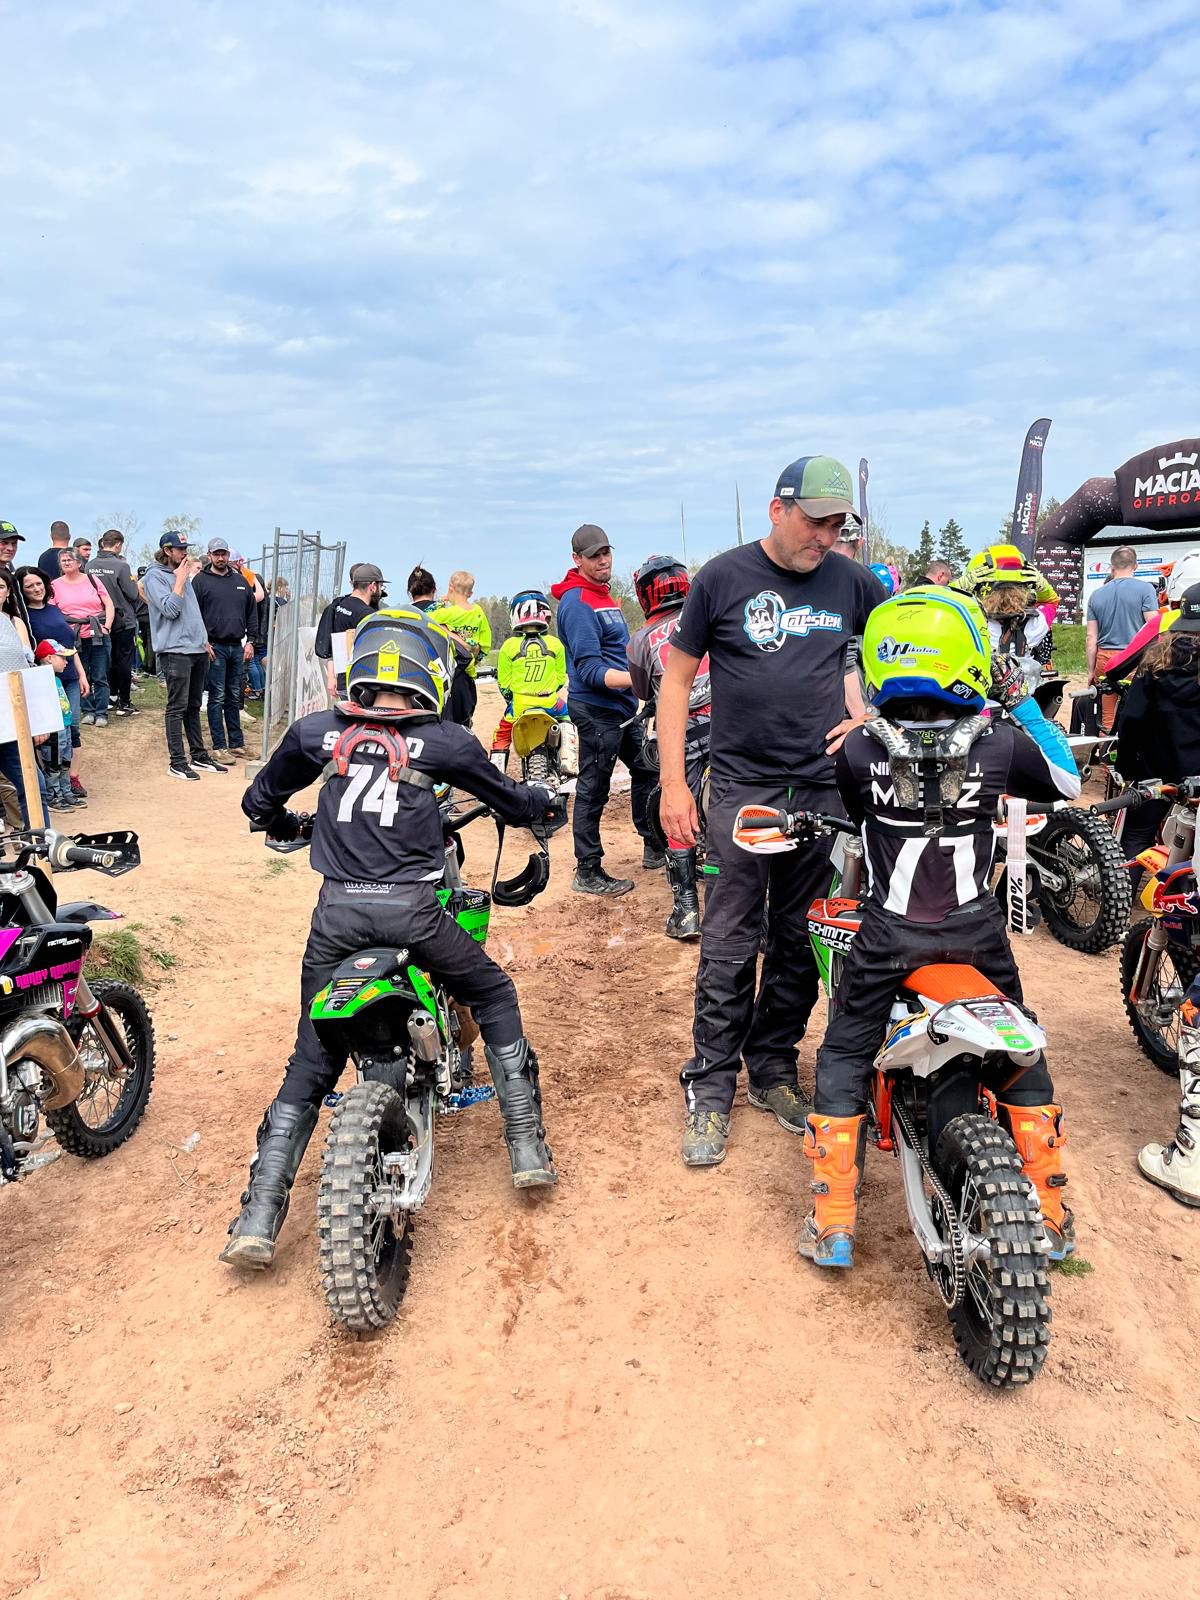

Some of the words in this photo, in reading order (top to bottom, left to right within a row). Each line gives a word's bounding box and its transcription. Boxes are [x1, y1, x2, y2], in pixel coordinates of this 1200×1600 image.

[1020, 493, 1033, 535] MACIAG
[524, 660, 547, 682] 77
[969, 762, 984, 777] J.
[337, 763, 400, 827] 74
[807, 920, 857, 943] SCHMITZ
[820, 937, 852, 952] RACING
